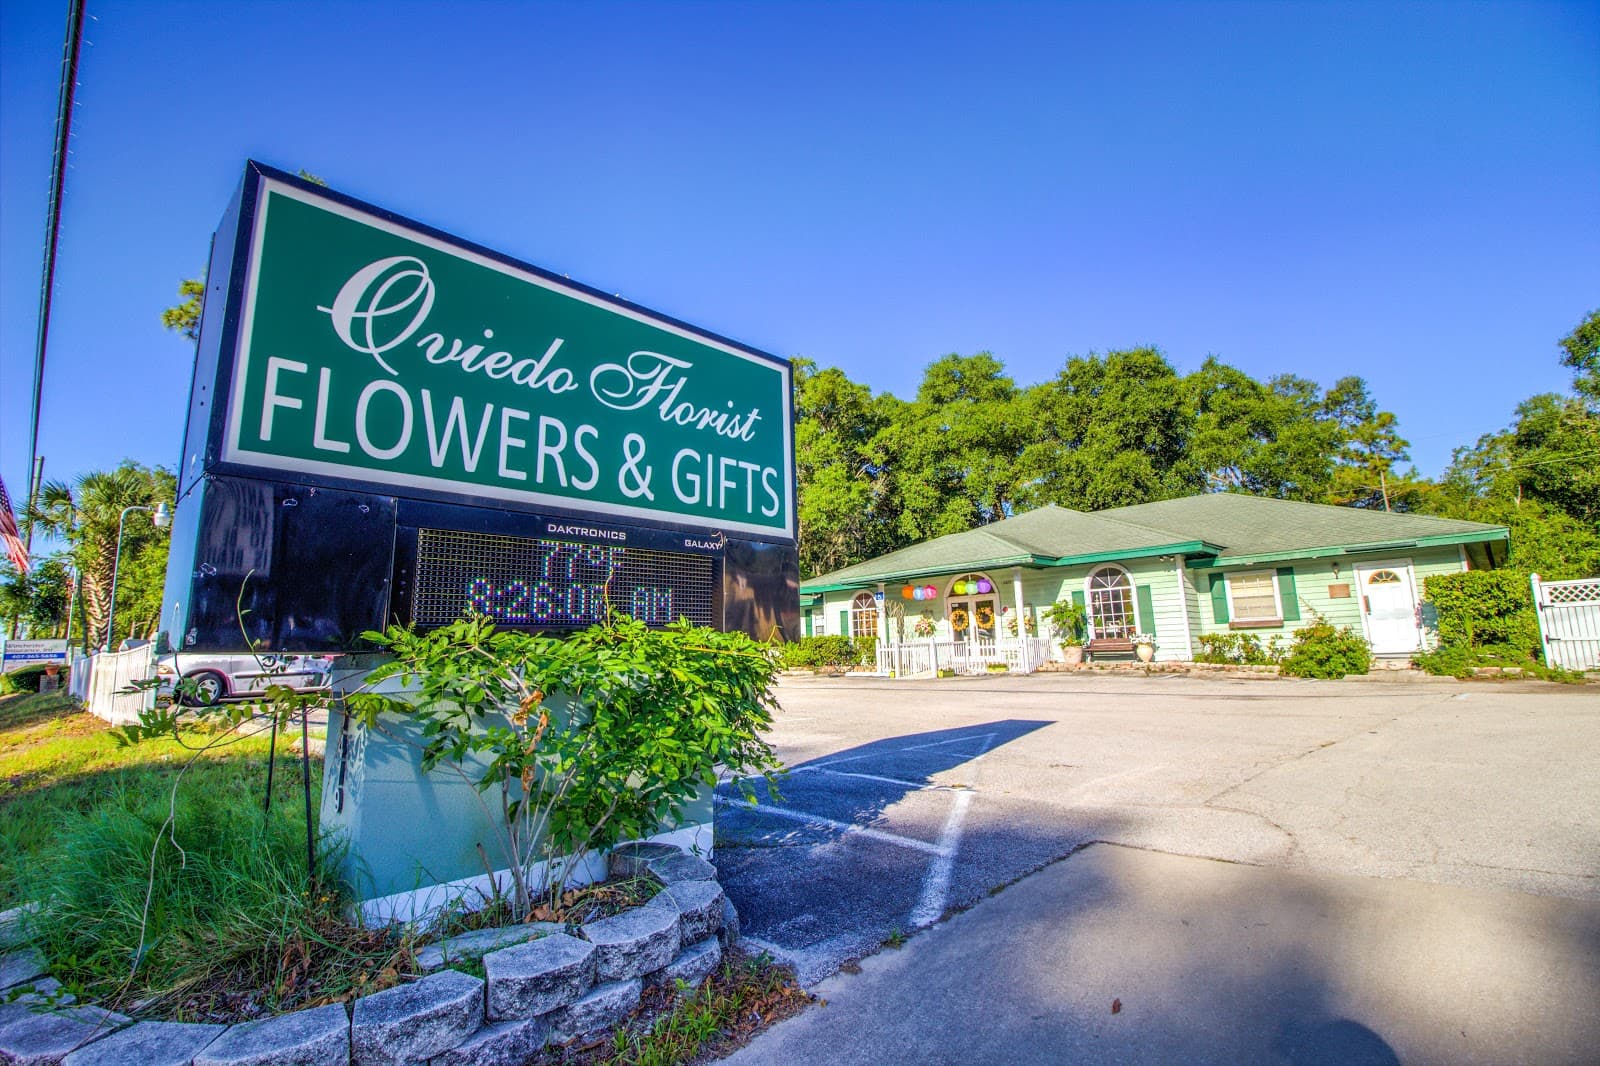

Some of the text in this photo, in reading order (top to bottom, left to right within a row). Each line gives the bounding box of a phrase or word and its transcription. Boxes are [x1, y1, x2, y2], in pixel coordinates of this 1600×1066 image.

[316, 256, 763, 443] Oviedo Florist
[259, 356, 780, 518] FLOWERS & GIFTS
[547, 523, 627, 540] DAKTRONICS
[684, 539, 721, 550] GALAXY
[633, 586, 672, 621] AM
